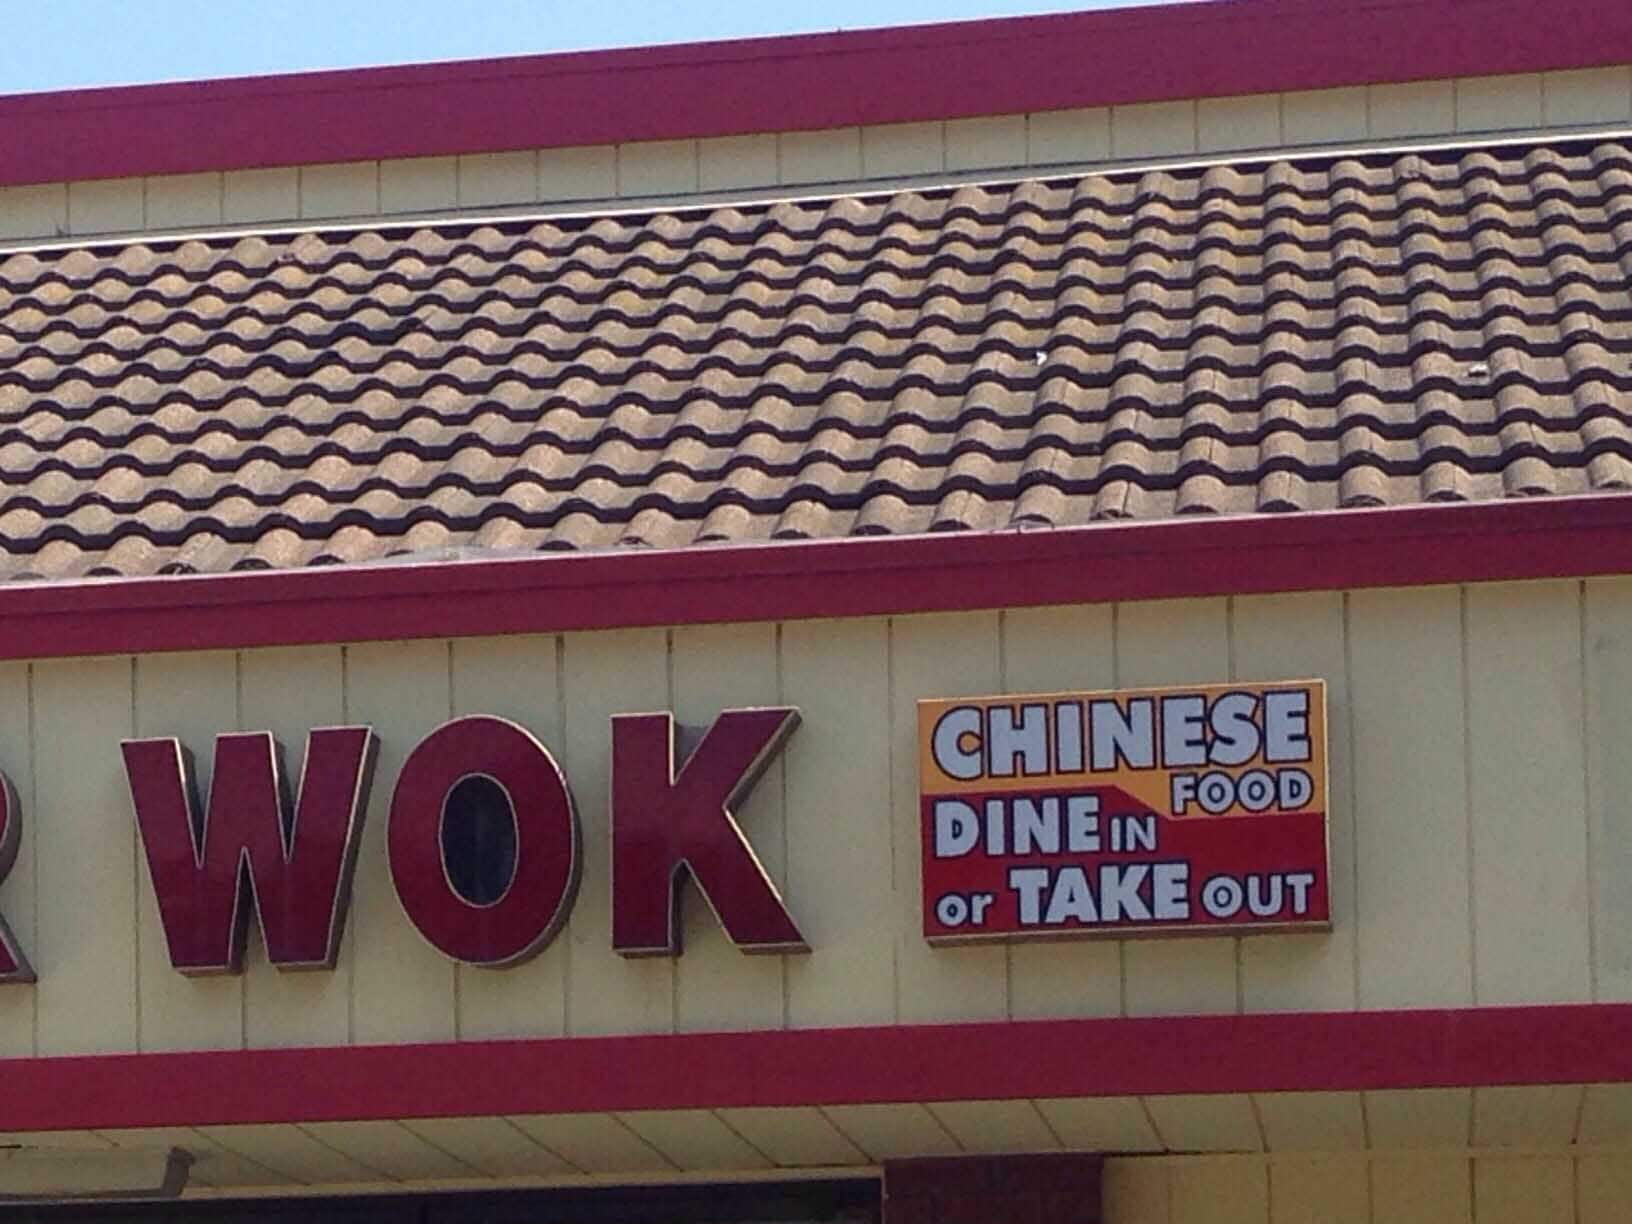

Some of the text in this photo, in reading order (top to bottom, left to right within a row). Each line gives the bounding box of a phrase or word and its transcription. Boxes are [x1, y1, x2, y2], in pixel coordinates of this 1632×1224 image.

[932, 690, 1311, 779] CHINESE
[1171, 768, 1314, 816] FOOD
[120, 706, 812, 975] WOK
[933, 795, 1158, 858] DINE IN
[935, 861, 1314, 927] or TAKE OUT
